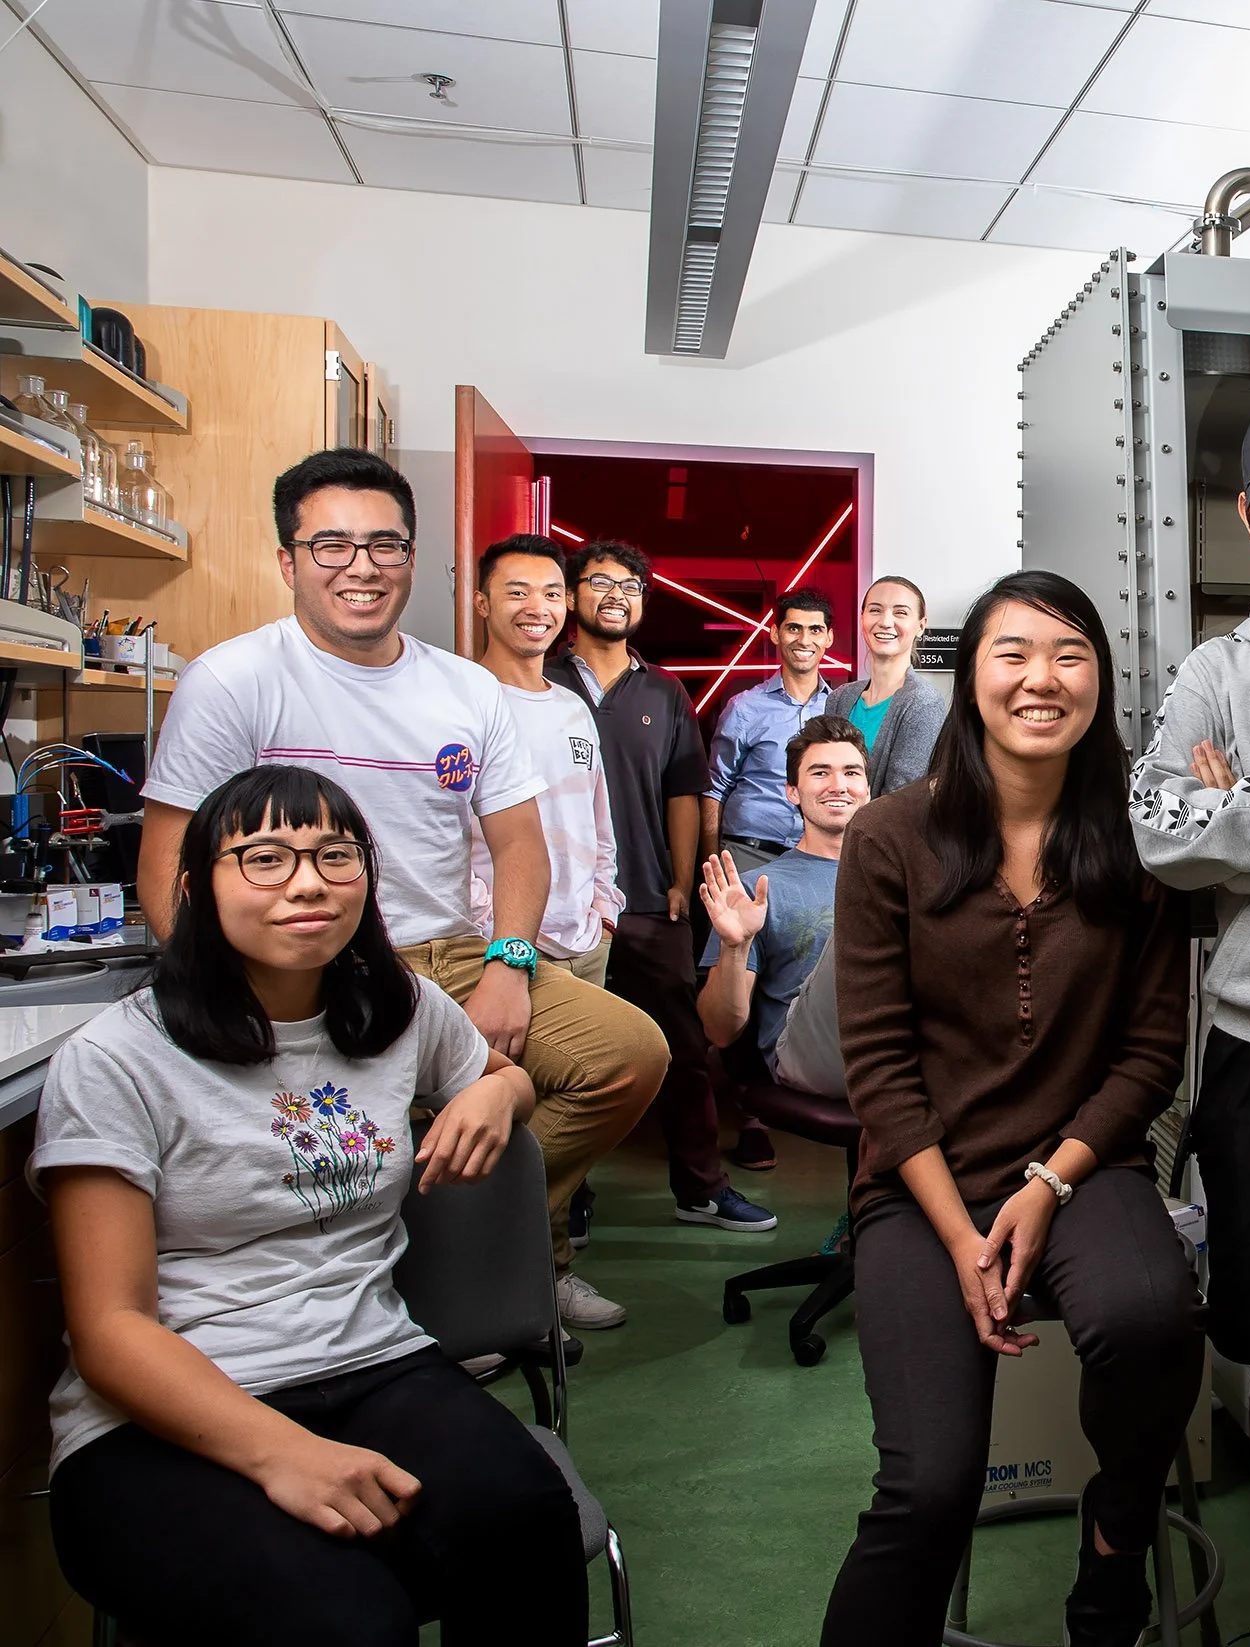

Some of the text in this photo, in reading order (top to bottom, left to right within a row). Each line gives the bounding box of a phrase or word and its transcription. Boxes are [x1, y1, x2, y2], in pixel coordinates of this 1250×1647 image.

[920, 654, 944, 664] 355A
[1024, 1459, 1052, 1478] MCS
[998, 1480, 1028, 1490] COOLING
[1029, 1477, 1053, 1488] SYSTEM
